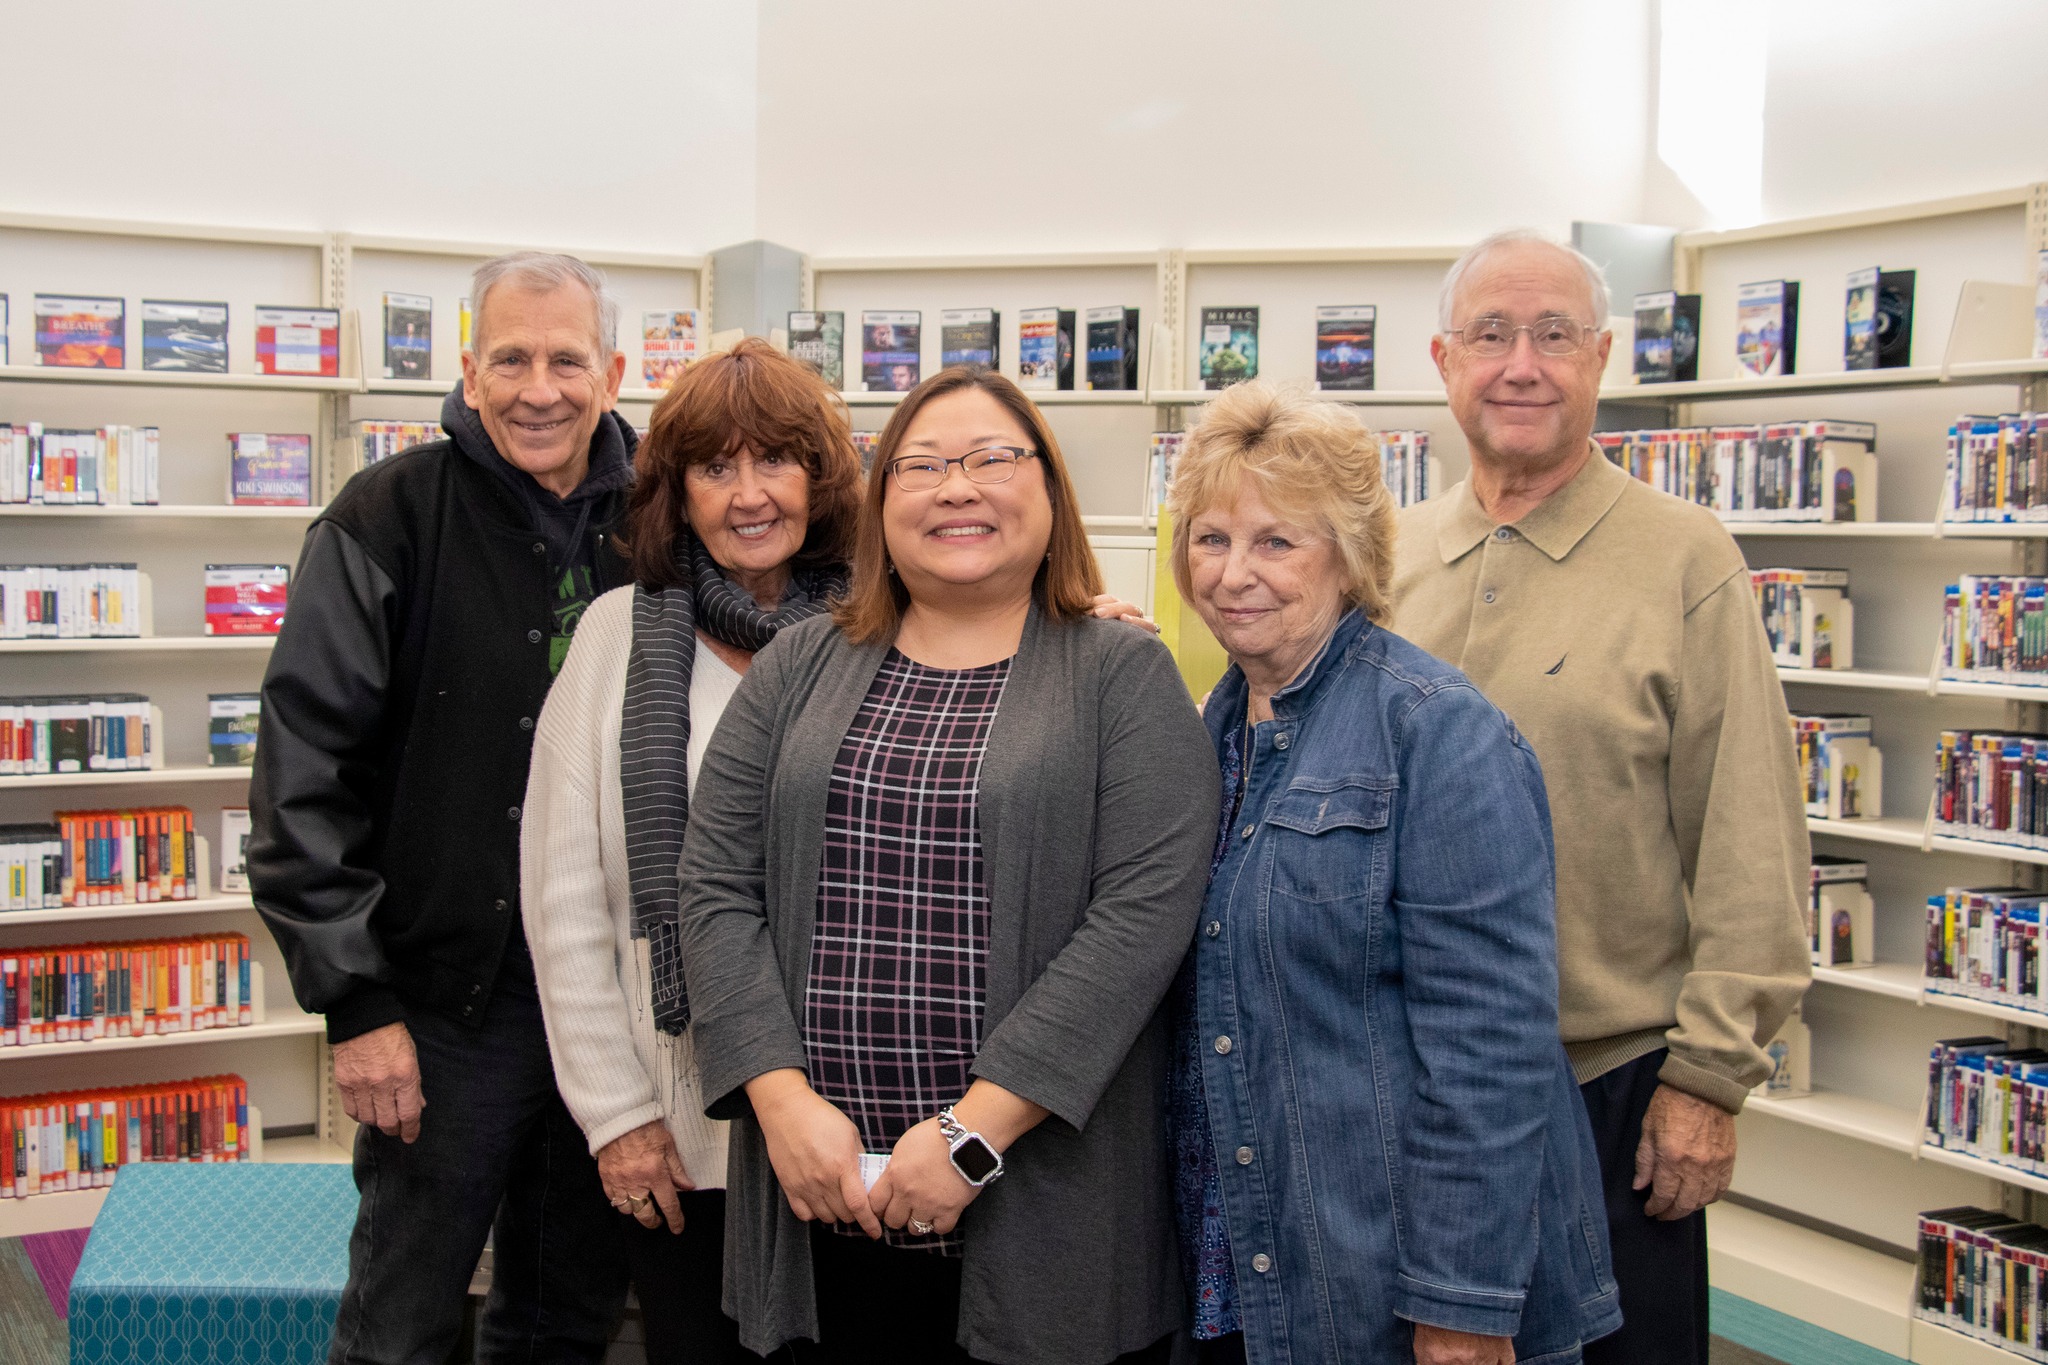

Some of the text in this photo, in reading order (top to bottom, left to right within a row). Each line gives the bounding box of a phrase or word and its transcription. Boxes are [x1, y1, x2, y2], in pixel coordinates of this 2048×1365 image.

[1207, 311, 1255, 321] MIMIC
[53, 319, 106, 330] BREATHE
[644, 341, 669, 351] BRING
[683, 341, 695, 350] ON
[236, 480, 303, 494] KIKI SWINSON
